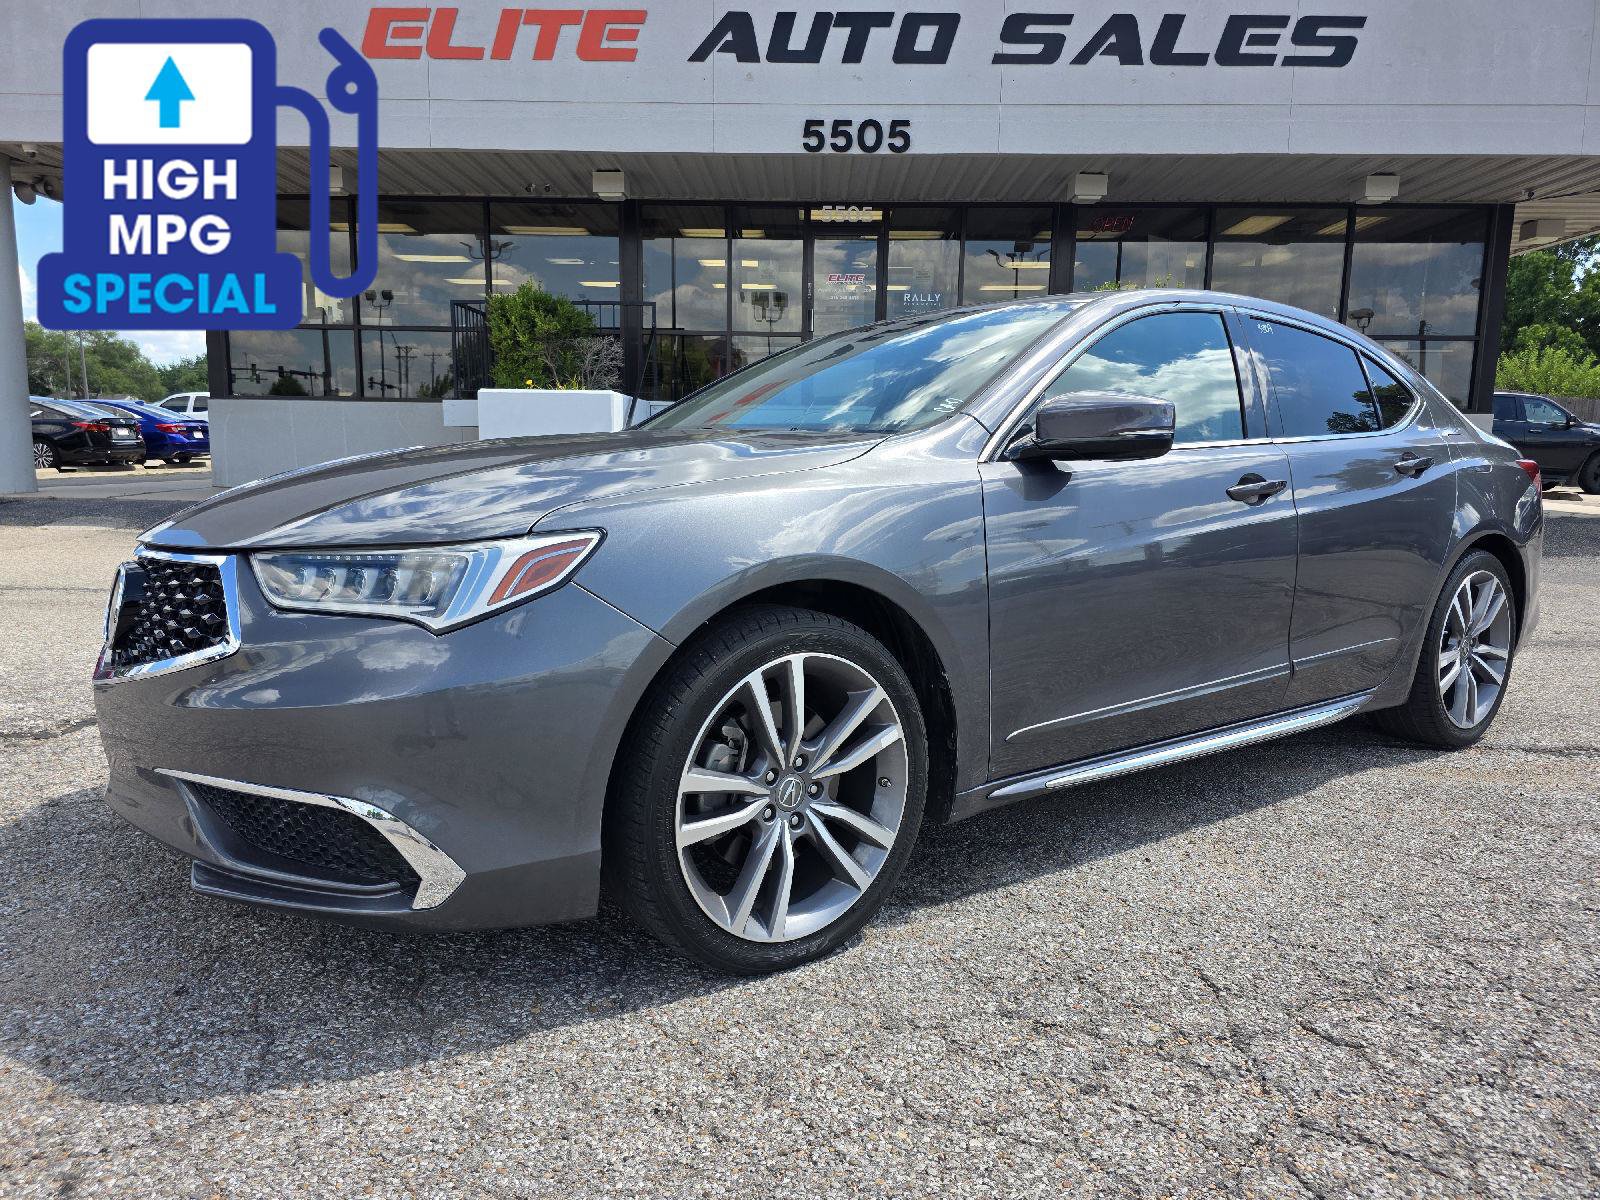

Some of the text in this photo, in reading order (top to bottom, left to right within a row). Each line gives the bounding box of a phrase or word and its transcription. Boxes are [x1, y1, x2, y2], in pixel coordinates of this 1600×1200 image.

[361, 8, 1367, 67] ELITE AUTO SALES
[802, 119, 911, 154] 5505
[822, 205, 873, 223] 5505
[828, 273, 866, 282] ELITE
[903, 293, 941, 302] RALLY
